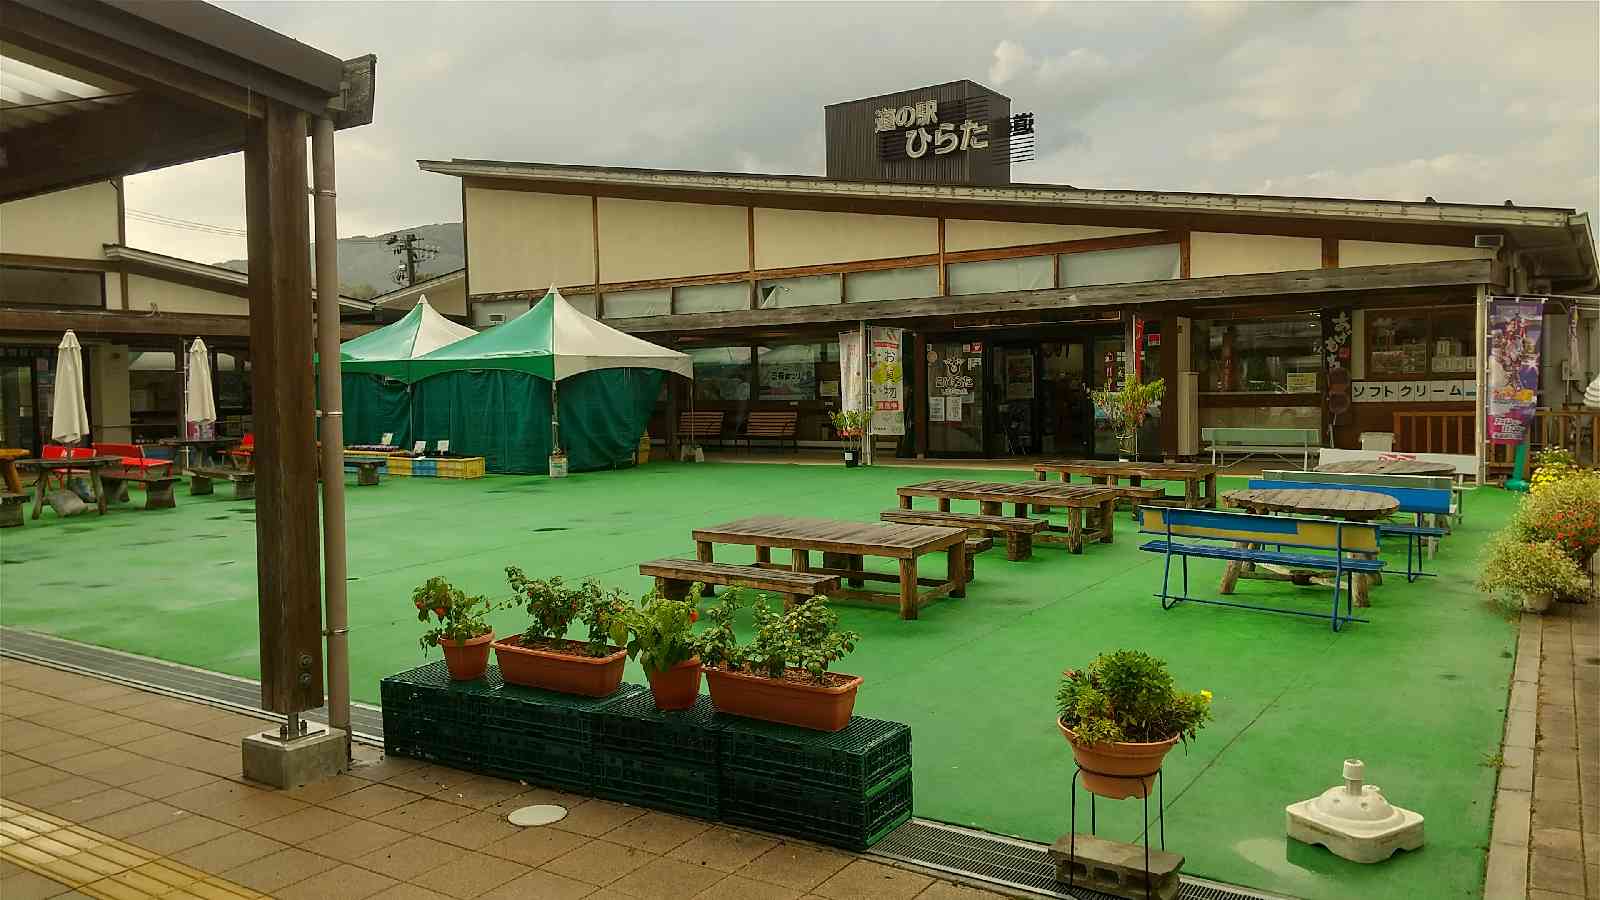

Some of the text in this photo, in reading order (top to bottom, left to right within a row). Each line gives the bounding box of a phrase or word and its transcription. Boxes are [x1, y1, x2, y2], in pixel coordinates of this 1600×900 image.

[874, 100, 938, 134] 道の駅
[905, 119, 989, 159] ひらた
[1353, 383, 1462, 398] ソフトクリーム
